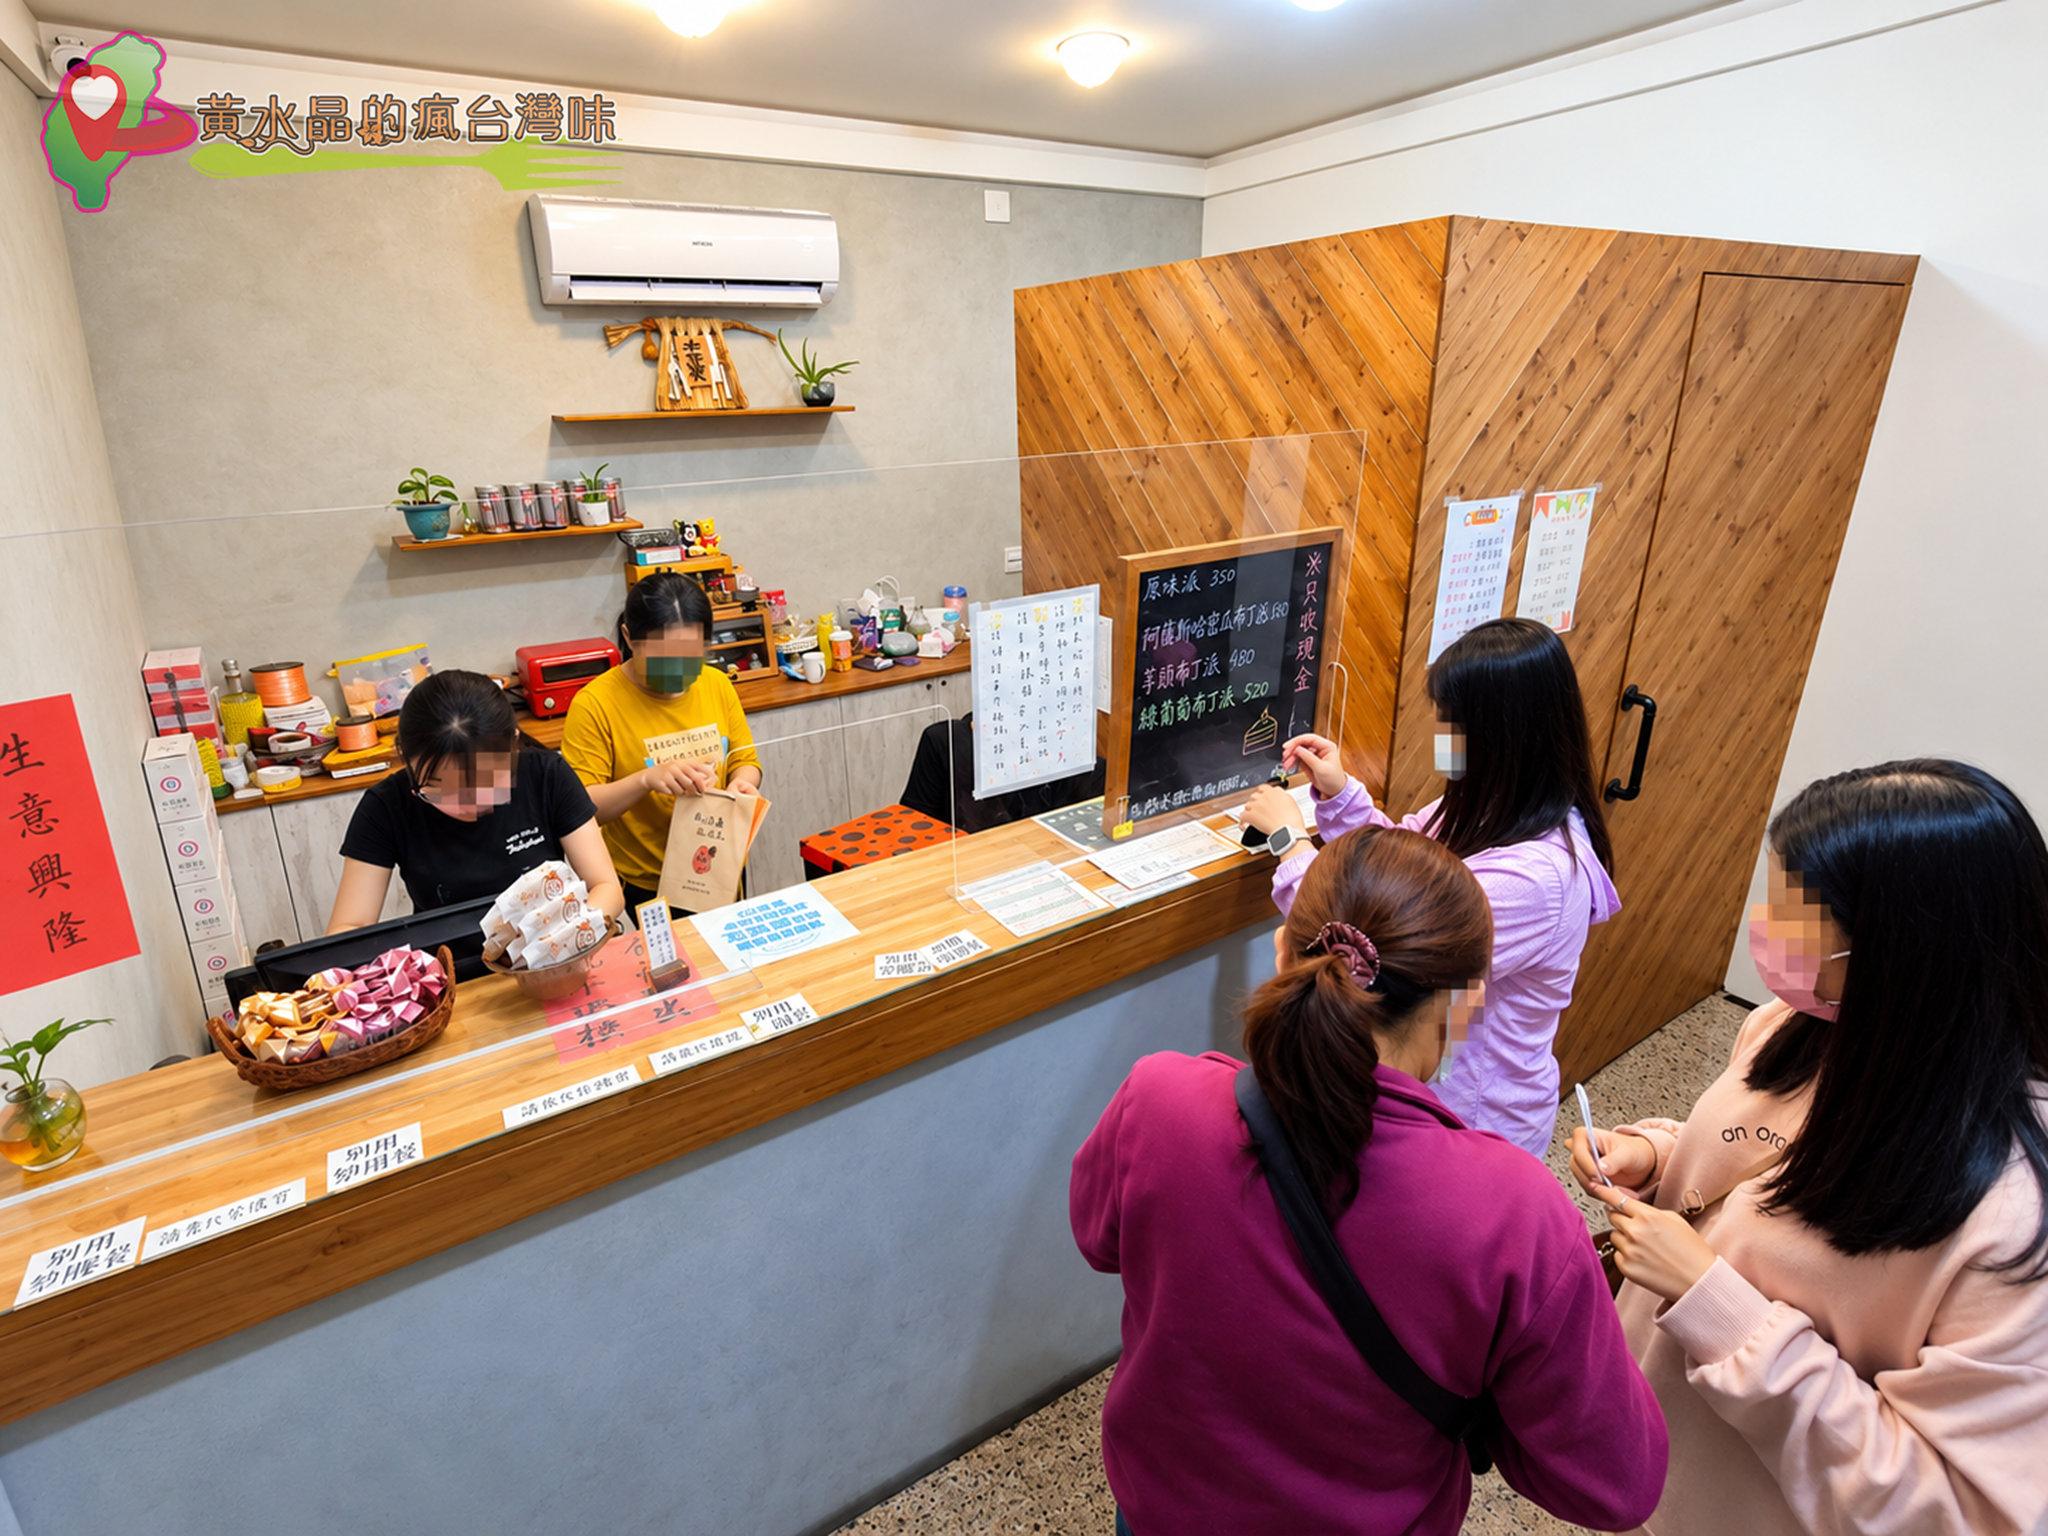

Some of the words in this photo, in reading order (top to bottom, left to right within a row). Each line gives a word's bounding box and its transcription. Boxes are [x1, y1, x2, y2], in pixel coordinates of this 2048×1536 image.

[1143, 570, 1201, 602] 原味派
[1209, 568, 1236, 588] 350
[1142, 652, 1220, 696] 芋頭布丁派
[1229, 649, 1255, 673] 480
[1243, 681, 1269, 703] 520
[0, 733, 87, 953] 生意興隆
[1721, 1126, 1748, 1143] an
